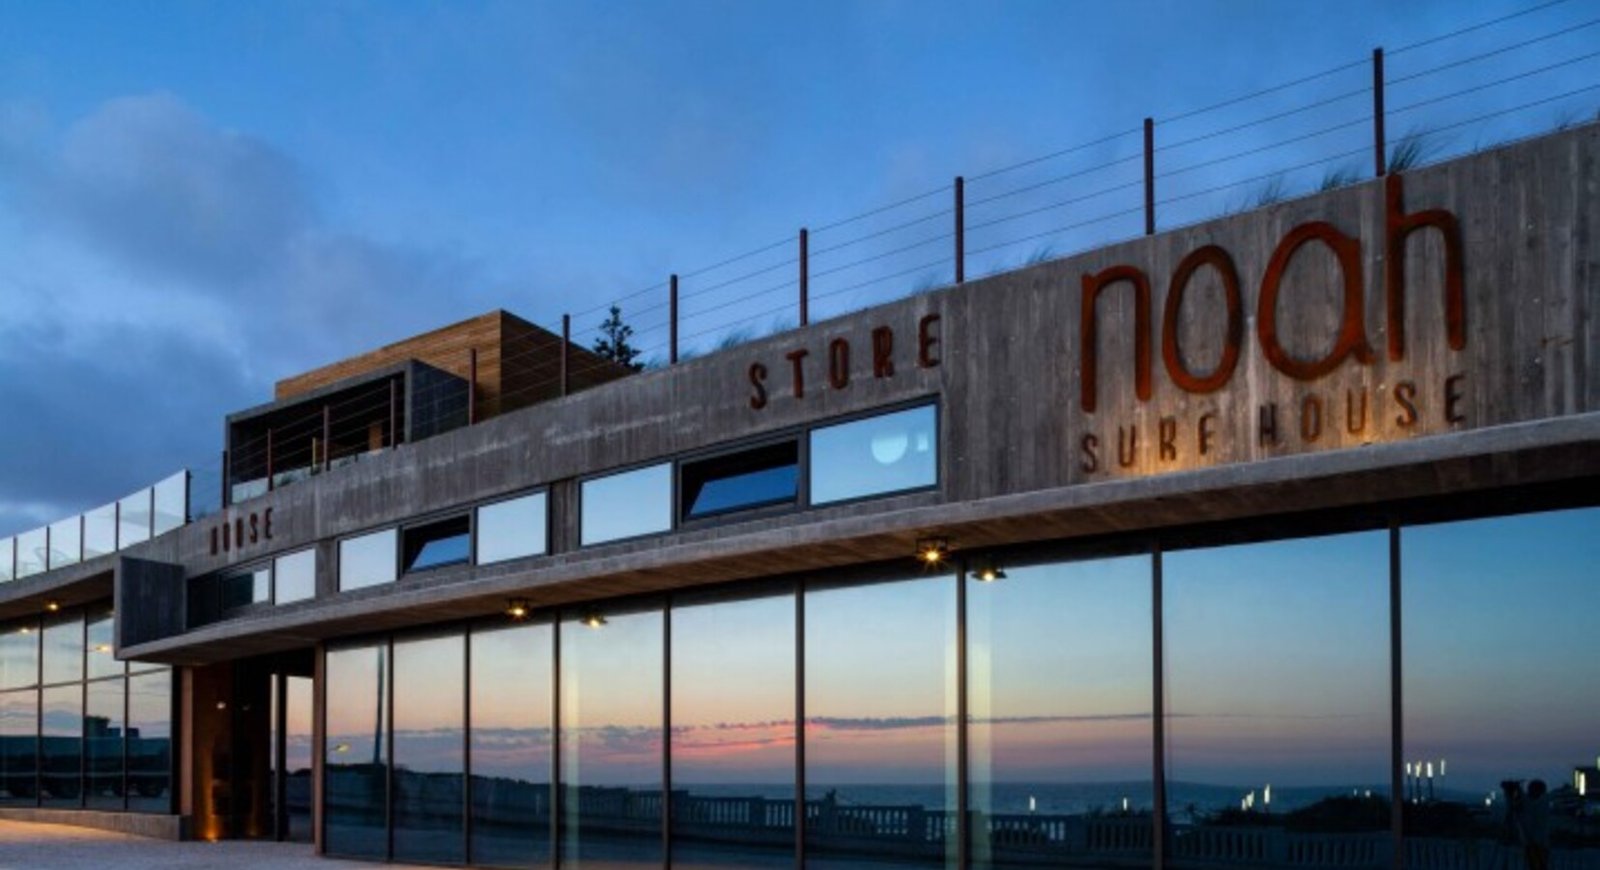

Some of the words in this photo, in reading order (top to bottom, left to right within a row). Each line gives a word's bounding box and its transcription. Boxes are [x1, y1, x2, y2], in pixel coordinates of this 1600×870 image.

[1080, 174, 1467, 414] noah
[749, 313, 942, 410] STORE
[1080, 413, 1217, 474] SURF
[1259, 374, 1467, 447] HOUSE
